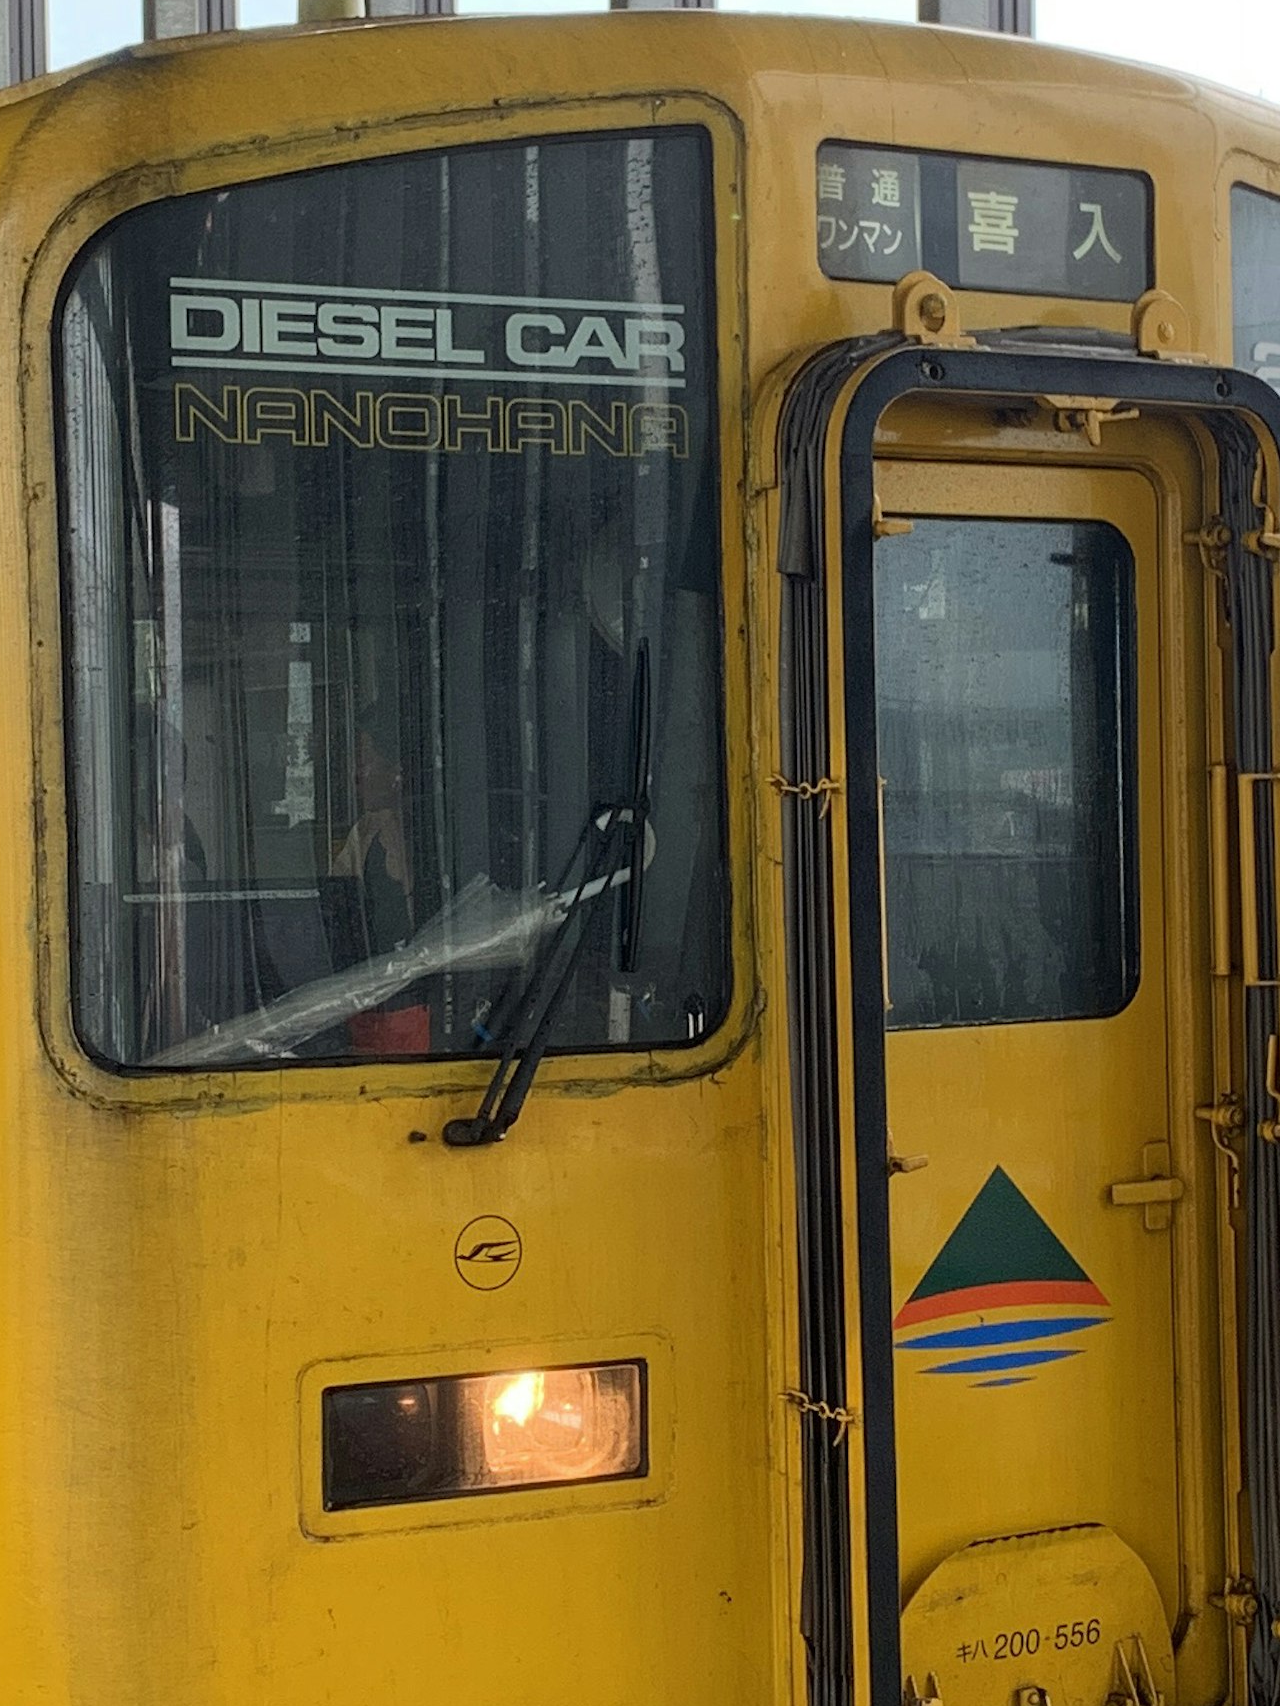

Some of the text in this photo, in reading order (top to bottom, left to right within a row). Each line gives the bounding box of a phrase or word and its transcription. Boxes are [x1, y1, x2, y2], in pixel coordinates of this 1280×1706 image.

[818, 163, 901, 208] 普通
[817, 213, 903, 256] ワンマン
[967, 190, 1123, 265] 喜入
[169, 293, 687, 373] DIESEL CAR
[174, 382, 690, 459] NANOHANA
